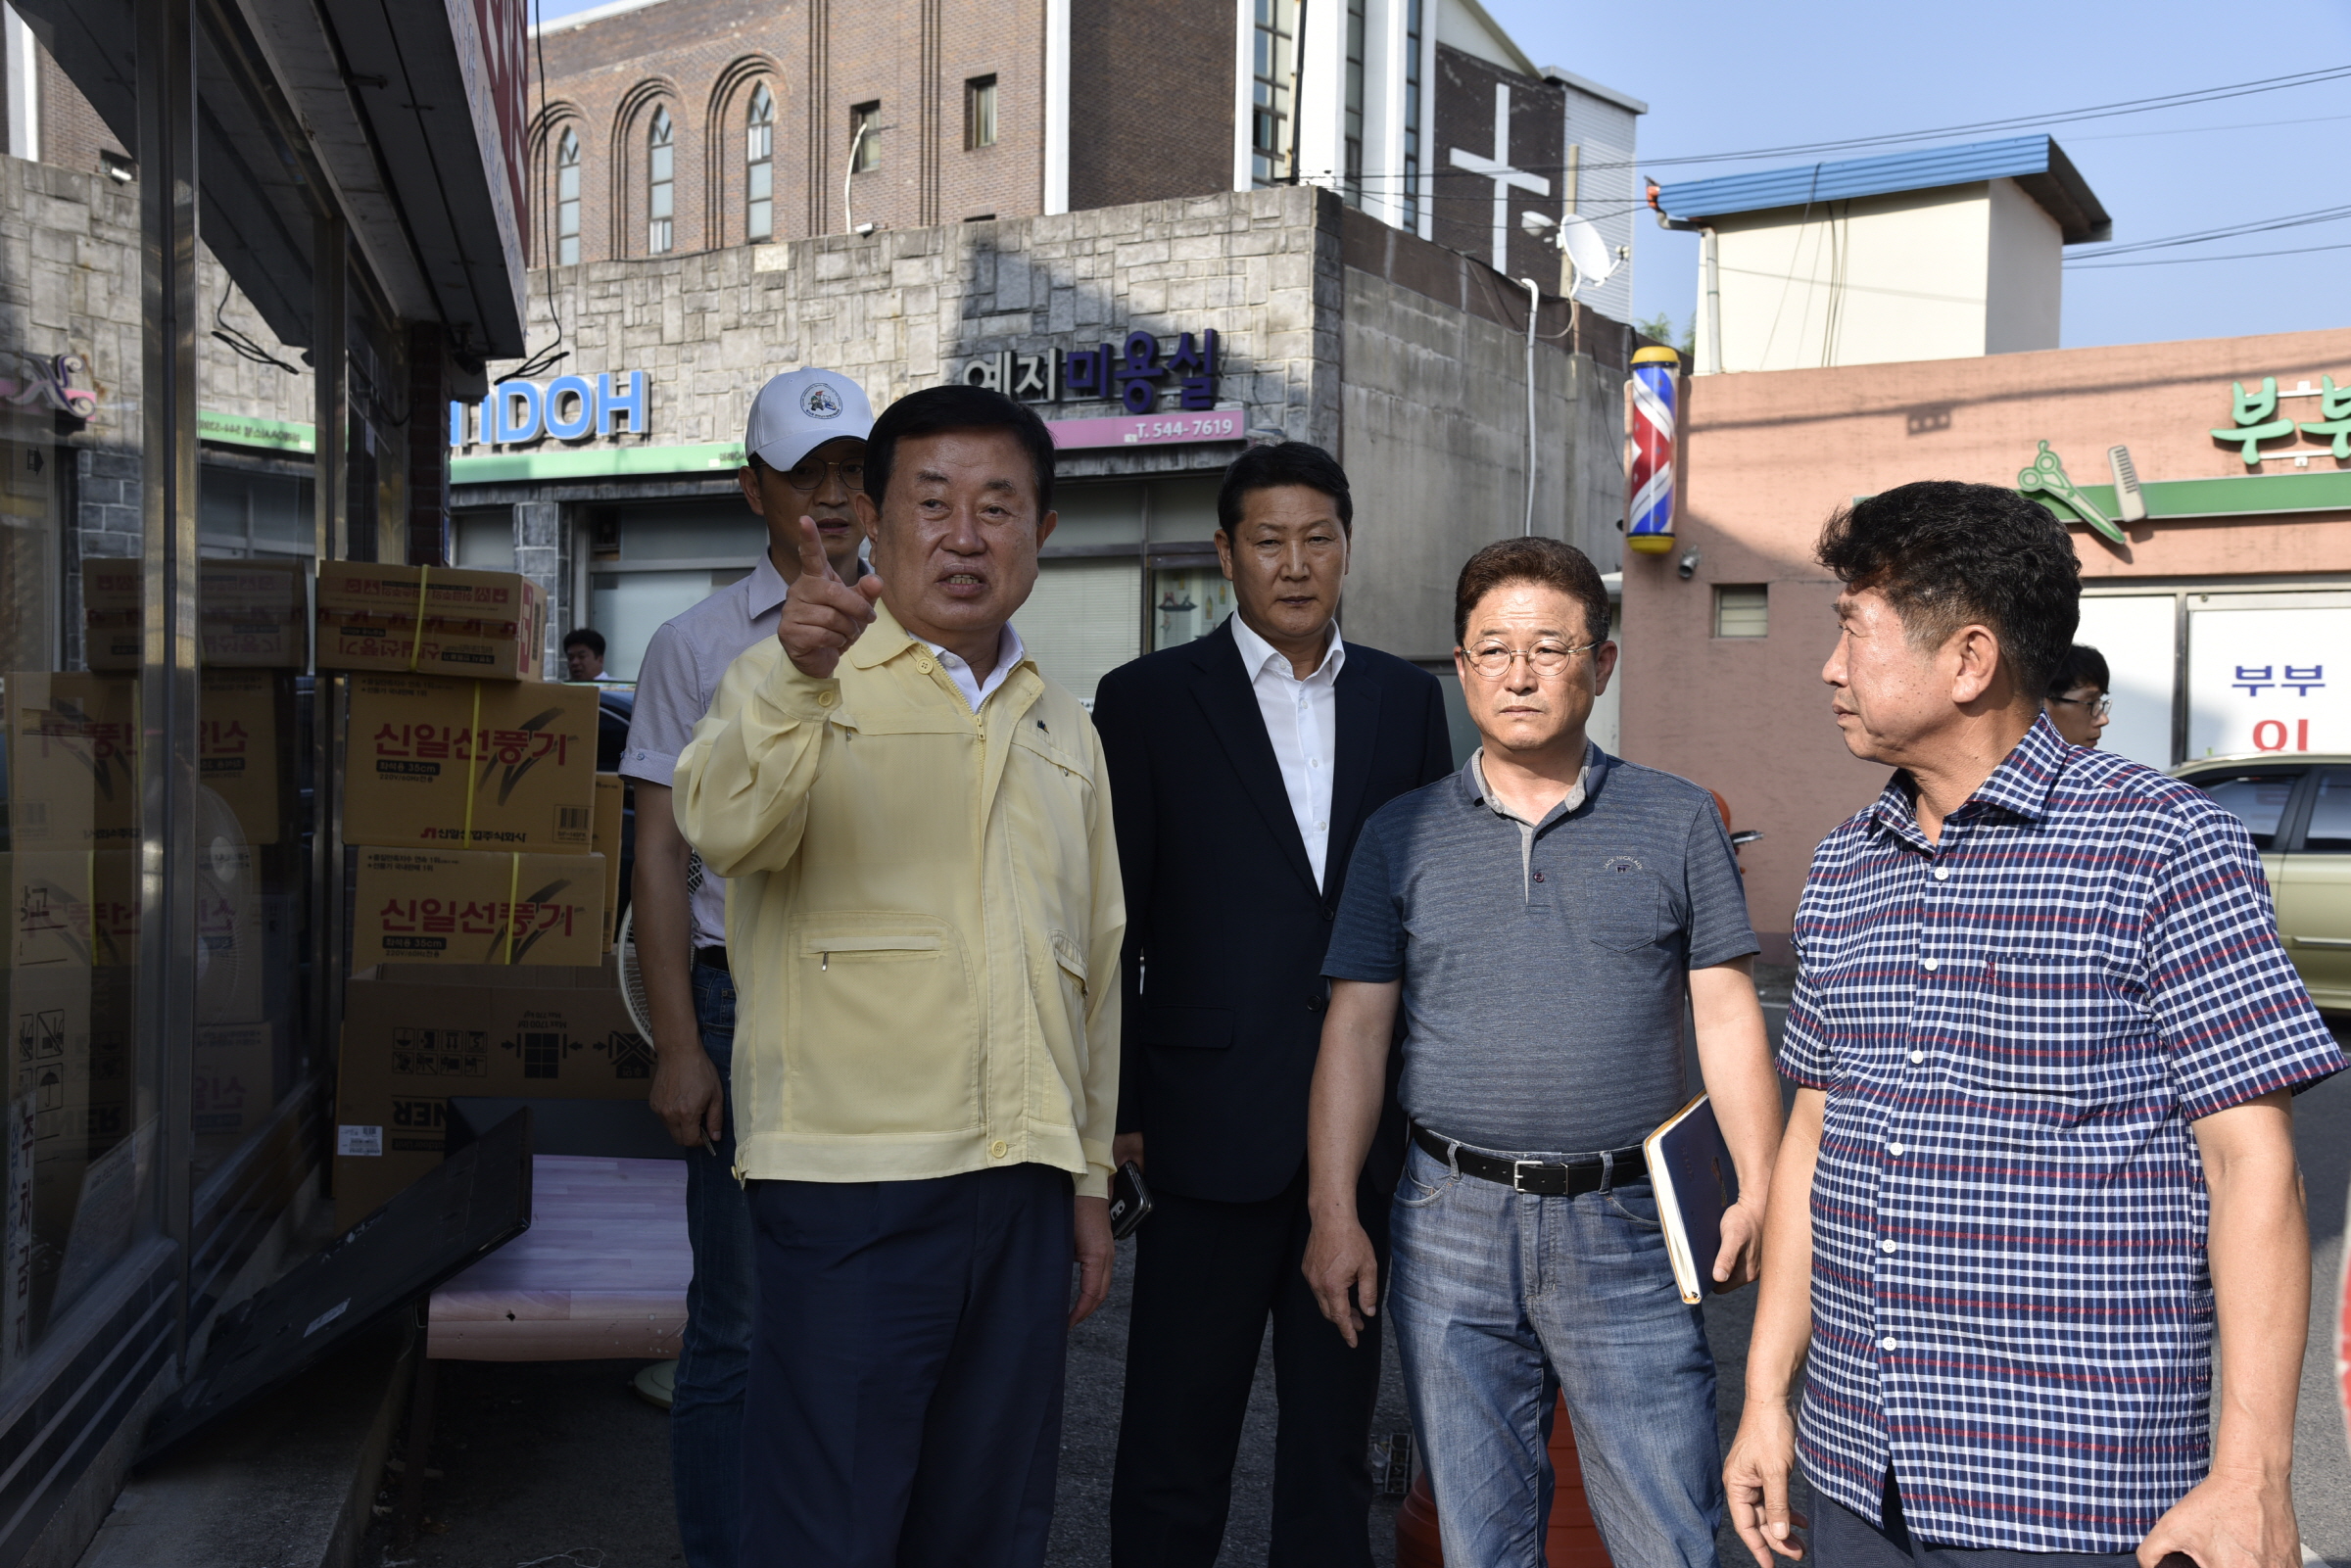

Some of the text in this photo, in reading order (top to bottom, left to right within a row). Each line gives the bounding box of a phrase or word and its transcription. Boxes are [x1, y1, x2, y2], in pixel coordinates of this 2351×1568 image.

[2231, 665, 2326, 696] 부부
[374, 723, 566, 766] 신일선풍기
[408, 762, 436, 774] 35cm
[380, 898, 573, 937] 신일선풍기
[413, 938, 442, 948] 35cm
[393, 1101, 447, 1126] NER
